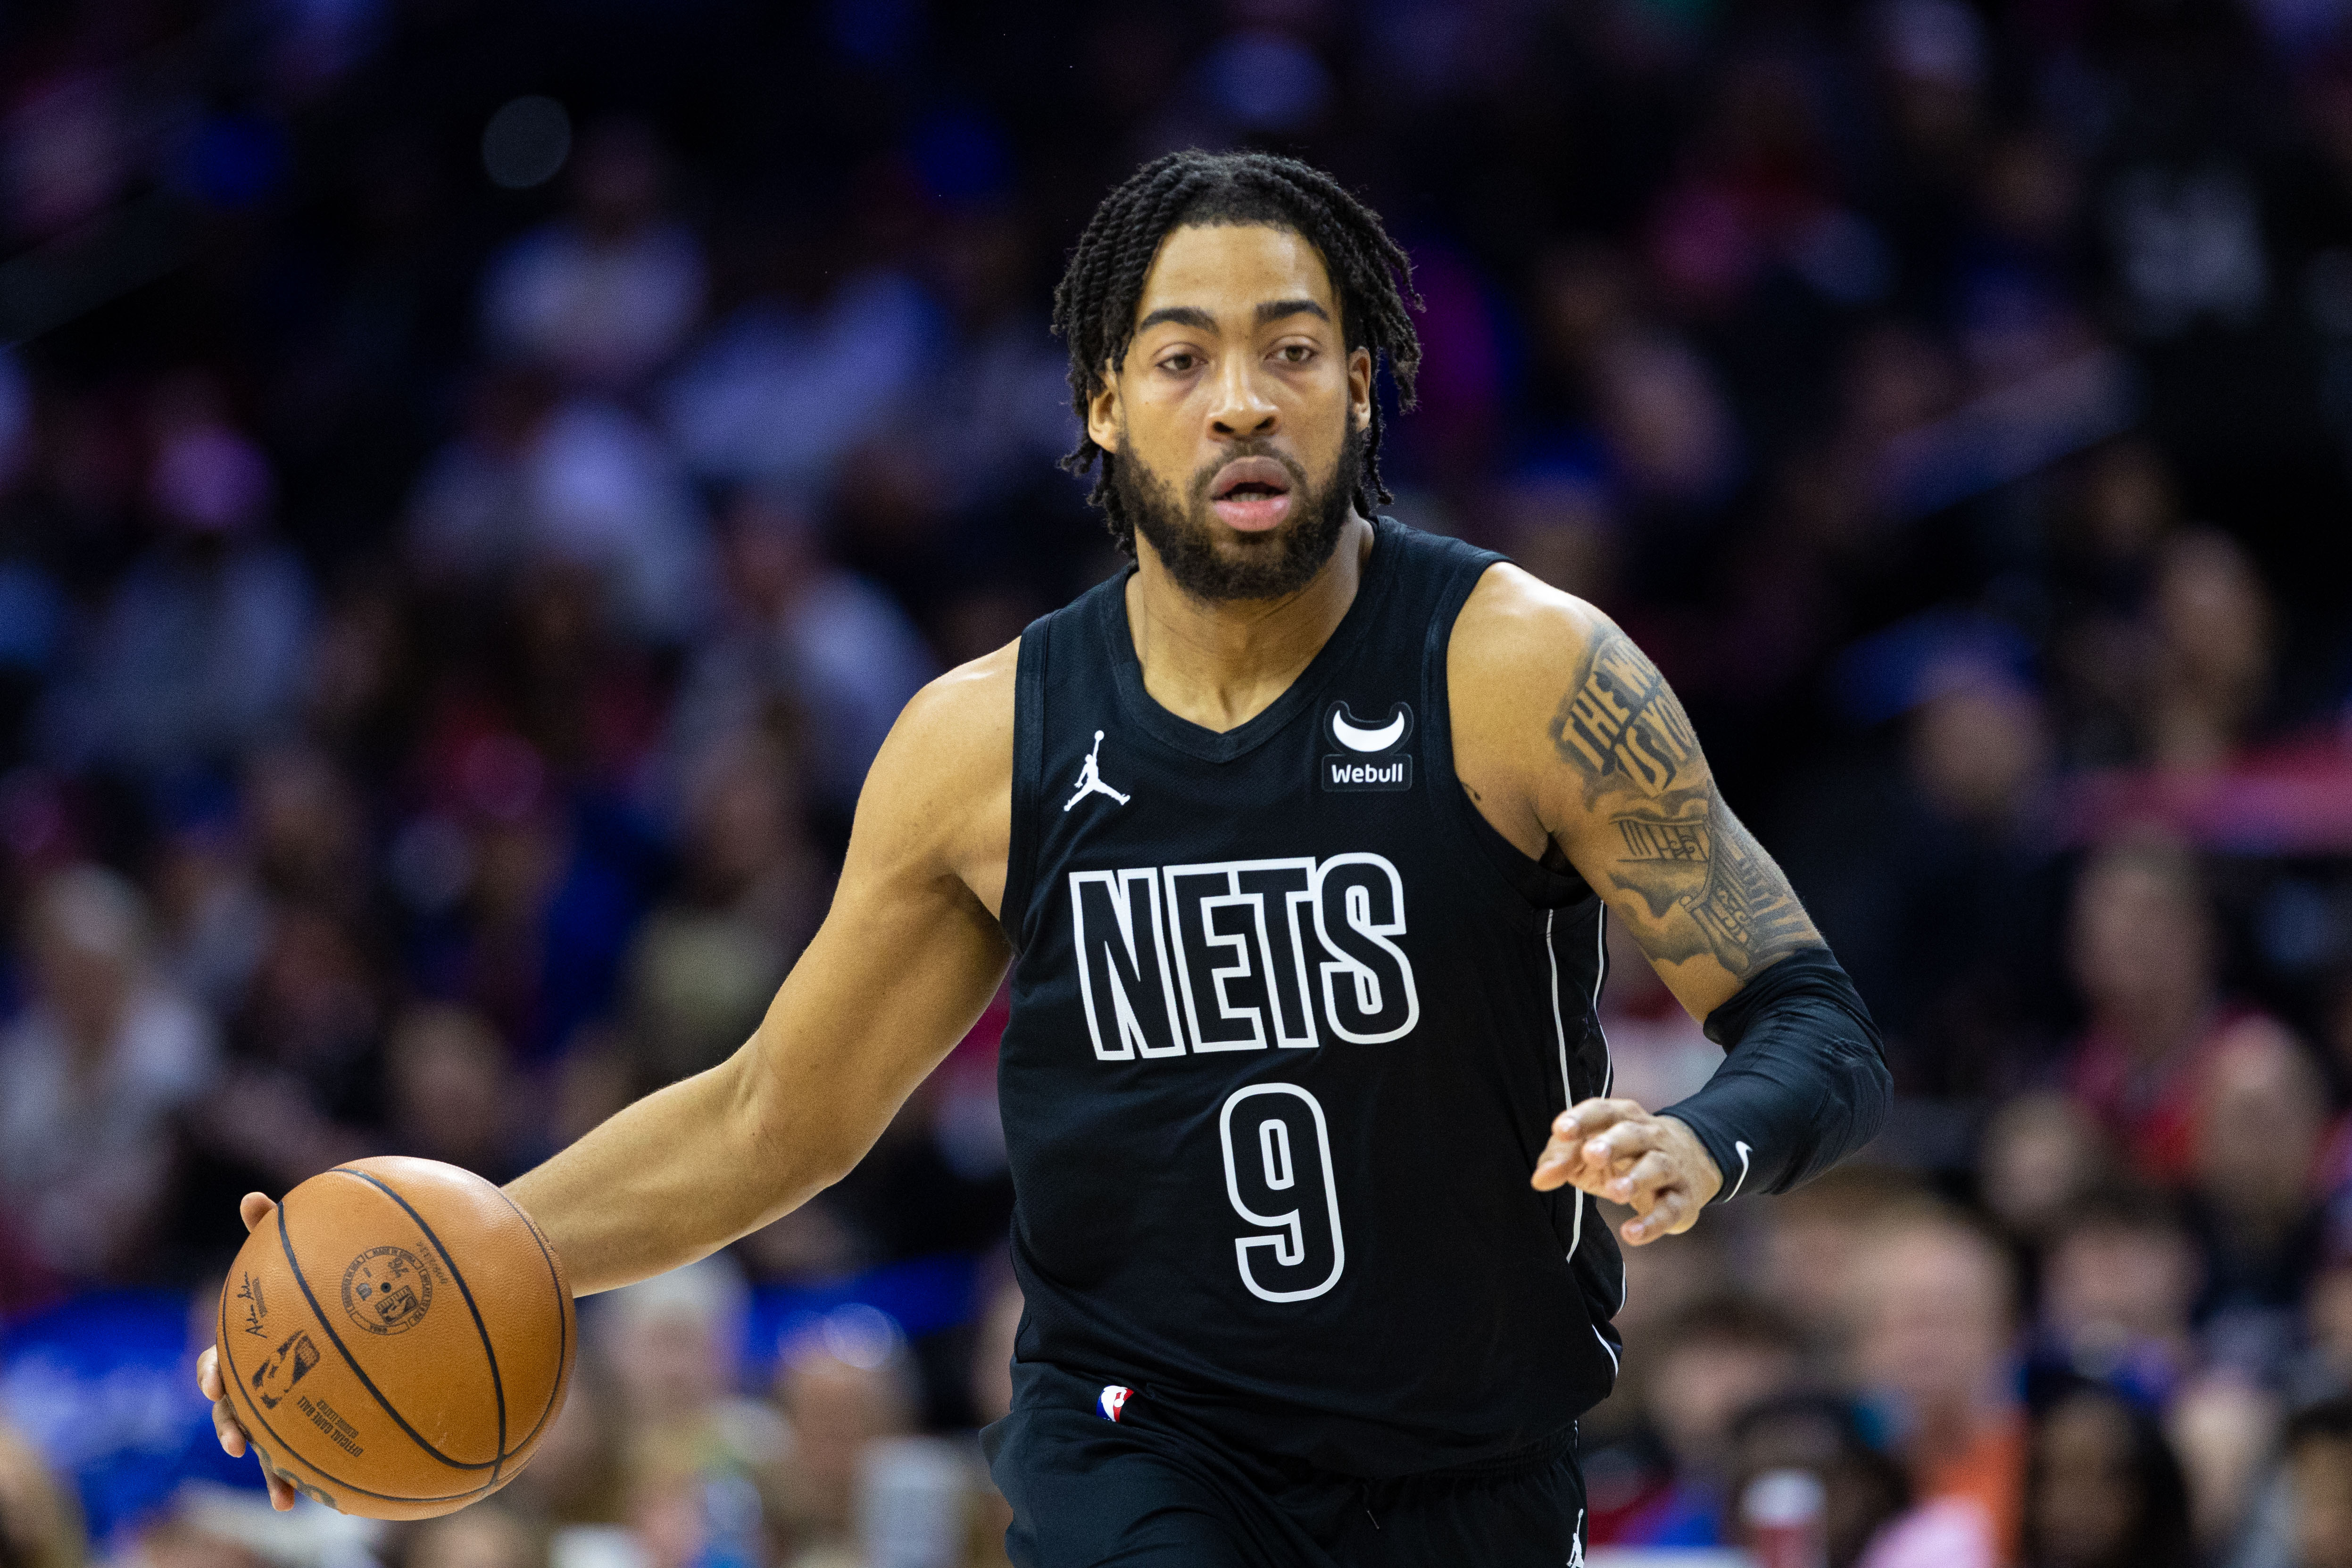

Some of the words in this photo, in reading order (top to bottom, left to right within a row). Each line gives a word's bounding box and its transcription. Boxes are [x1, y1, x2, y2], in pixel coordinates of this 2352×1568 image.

[1331, 763, 1403, 783] Webull
[1069, 852, 1420, 1061] NETS
[1219, 1082, 1345, 1303] 9
[297, 1395, 316, 1417] BALL
[310, 1411, 334, 1435] GAME
[331, 1429, 364, 1458] OFFICIAL
